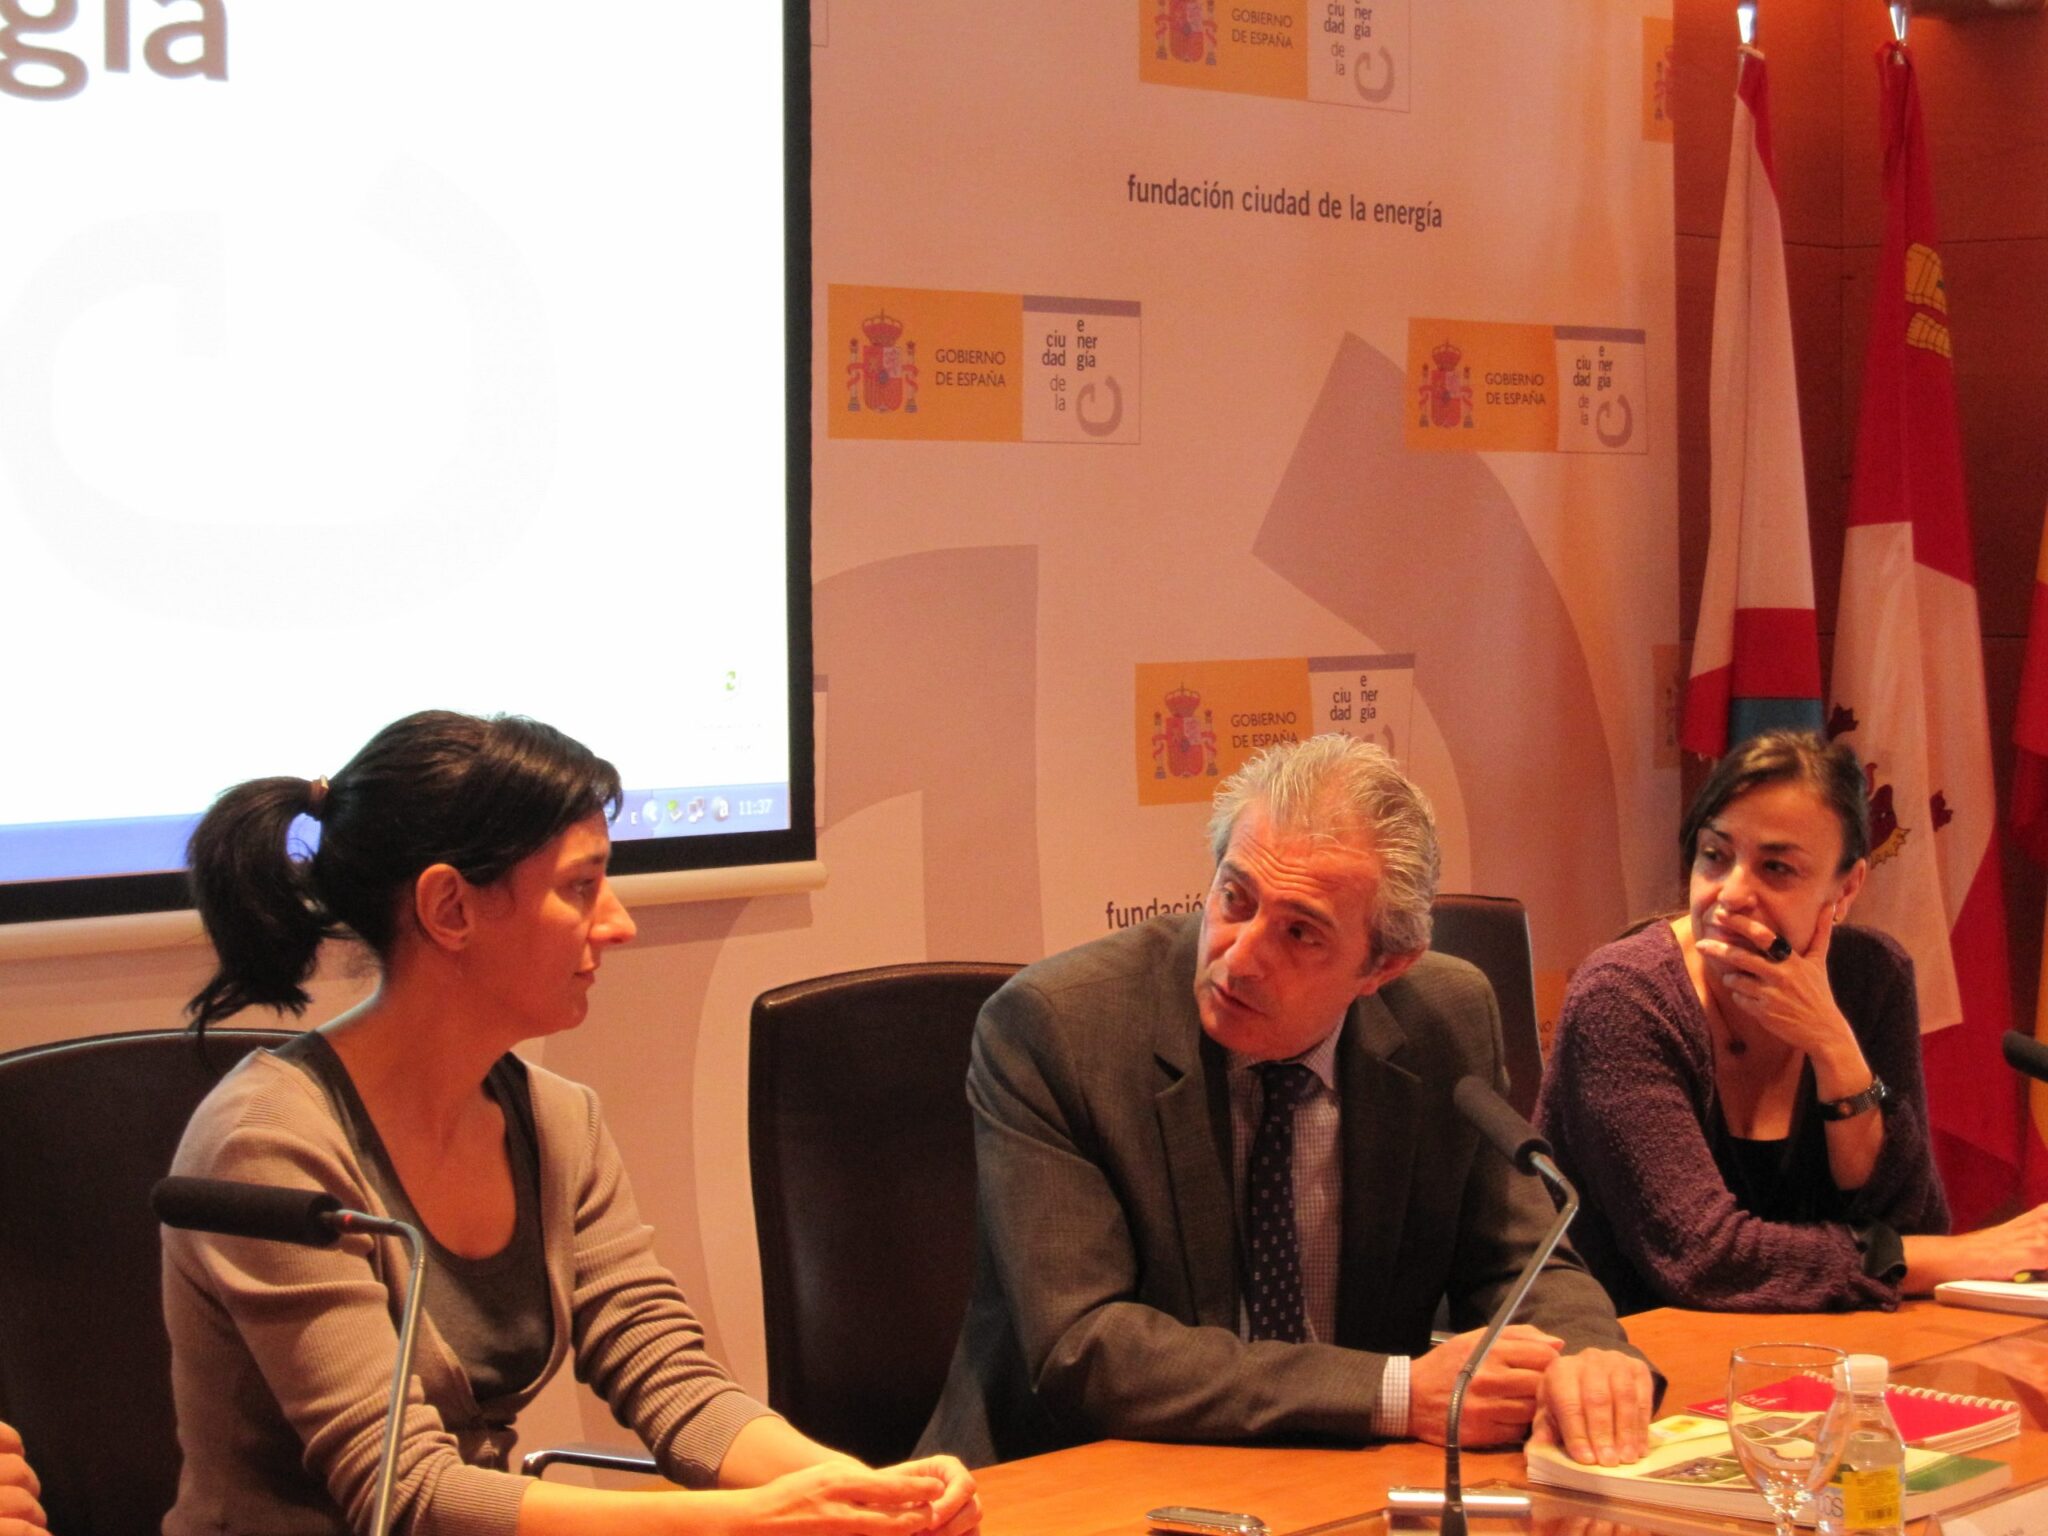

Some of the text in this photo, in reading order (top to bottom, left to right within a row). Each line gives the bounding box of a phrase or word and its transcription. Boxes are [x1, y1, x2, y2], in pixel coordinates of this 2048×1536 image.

[1327, 0, 1345, 17] ciu
[1354, 7, 1373, 20] ner
[1231, 7, 1293, 28] GOBIERNO
[1323, 17, 1345, 34] dad
[1231, 29, 1294, 49] DE ESPAÑA
[1331, 42, 1345, 58] de
[1335, 60, 1345, 76] la
[1127, 174, 1443, 233] fundación ciudad de la energía
[1076, 319, 1085, 332] e
[1046, 329, 1066, 348] ciu
[1077, 335, 1098, 349] ner
[935, 349, 1006, 366] GOBIERNO
[1042, 349, 1066, 367] dad
[1576, 355, 1591, 371] ciu
[1598, 358, 1613, 372] ner
[936, 370, 1006, 387] DE ESPAÑA
[1050, 374, 1066, 392] de
[1485, 372, 1544, 386] GOBIERNO
[1573, 371, 1591, 387] dad
[1054, 393, 1066, 411] la
[1486, 390, 1546, 406] DE ESPAÑA
[1578, 394, 1590, 408] de
[1360, 675, 1368, 687] e
[1333, 687, 1351, 703] ciu
[1360, 689, 1379, 703] ner
[1231, 711, 1296, 727] GOBIERNO
[1330, 704, 1351, 721] dad
[1232, 729, 1299, 749] DE ESPAÑA
[739, 799, 773, 816] 11:37
[1106, 893, 1204, 930] fundació
